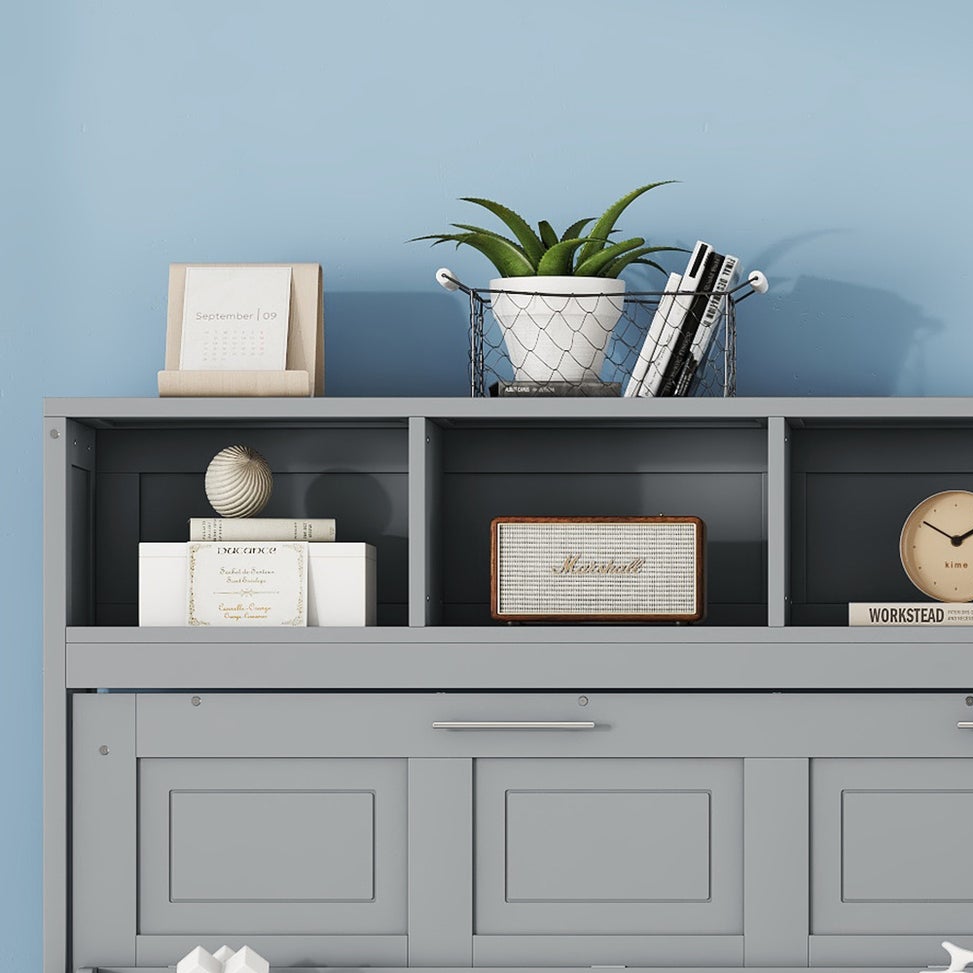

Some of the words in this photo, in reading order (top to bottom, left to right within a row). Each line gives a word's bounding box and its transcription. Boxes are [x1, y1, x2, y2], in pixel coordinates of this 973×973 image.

[195, 311, 253, 321] September
[262, 311, 278, 320] 09
[551, 553, 646, 574] Marshall
[944, 560, 969, 569] kime
[869, 608, 945, 623] WORKSTEAD
